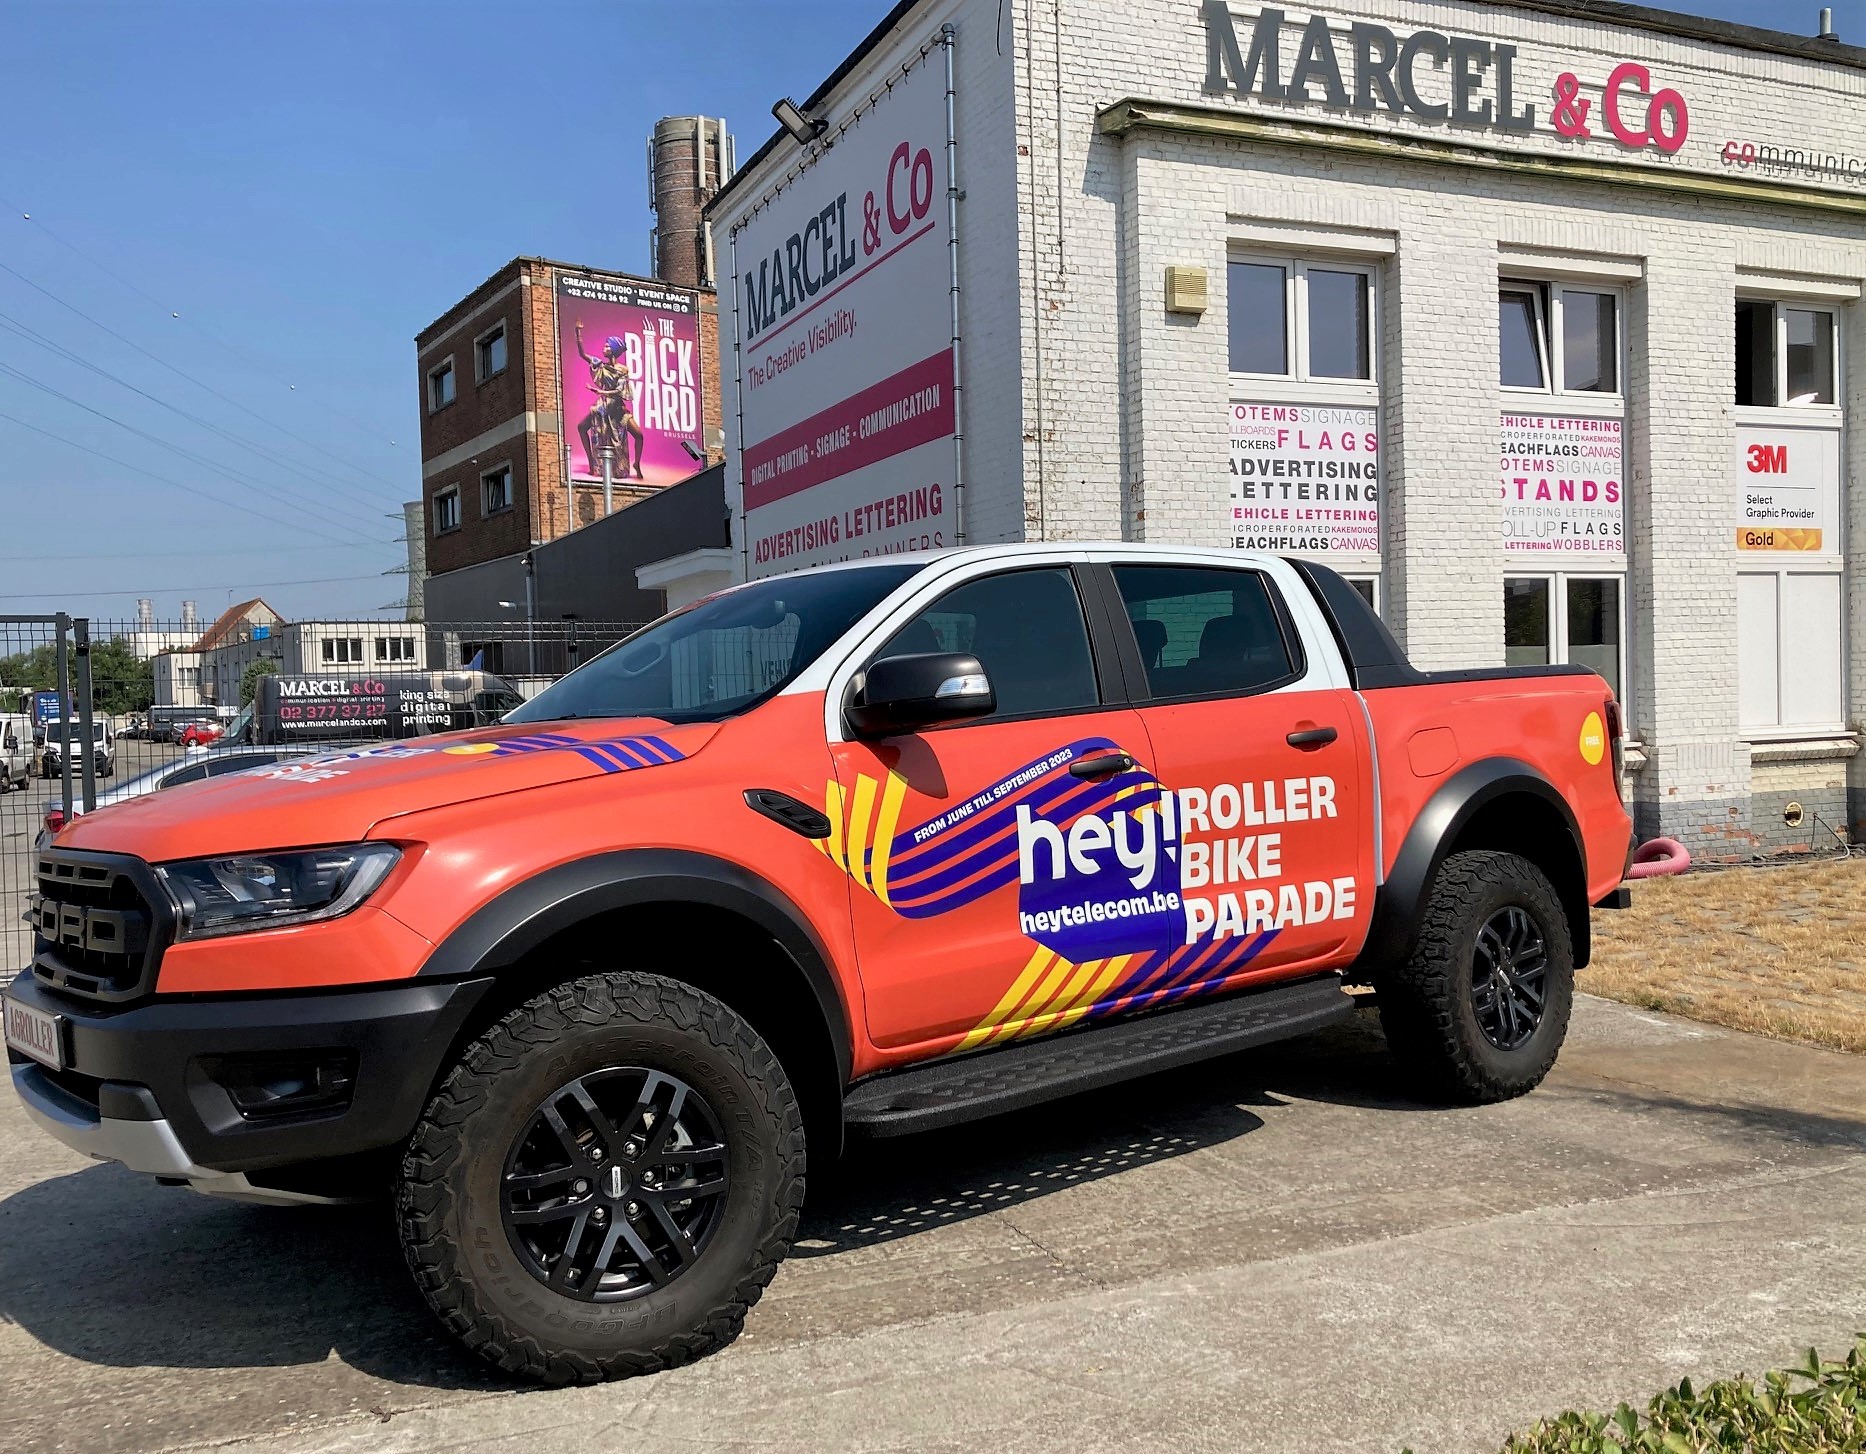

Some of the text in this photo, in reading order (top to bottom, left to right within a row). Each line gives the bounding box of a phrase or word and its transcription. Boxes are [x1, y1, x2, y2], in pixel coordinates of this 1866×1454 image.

[1205, 0, 1688, 152] MARCEL & Co
[1726, 141, 1866, 178] communic
[745, 142, 933, 340] MARCEL & Co
[562, 277, 690, 304] CREATIVE STUDIO EVENT SPACE
[582, 290, 596, 298] 474
[597, 292, 607, 300] 92
[637, 299, 652, 307] FIND
[658, 317, 675, 338] THE
[748, 308, 857, 391] The Creative Visibility.
[624, 331, 694, 388] BACK
[629, 378, 697, 433] YARD
[1230, 405, 1376, 425] OTEMS SIGNAGE
[1230, 426, 1275, 436] ILLBOARDS
[1551, 419, 1620, 432] LETTERING
[664, 431, 696, 440] BRUSSELS
[751, 464, 776, 486] DIGITAL
[777, 444, 809, 475] PRINTING
[816, 425, 850, 458] SIGNAGE
[859, 384, 940, 439] COMMUNICATION
[1277, 429, 1377, 452] FLAGS
[1500, 431, 1580, 442] CROPERFORATED
[1231, 439, 1276, 450] TICKERS
[1501, 442, 1620, 459] EACHFLAGS CANVAS
[1501, 458, 1620, 475] OTEMS SIGNAGE
[1746, 444, 1787, 473] 3M
[1746, 494, 1773, 505] Select
[1231, 508, 1377, 521] EHICLE LETTERING
[1502, 507, 1621, 518] VERTISING LETTERING
[1746, 507, 1815, 519] Graphic Provider
[755, 483, 943, 565] ADVERTISING LETTERING
[1233, 524, 1330, 534] ICROPERFORATED
[1501, 520, 1556, 537] OLL-UP
[1561, 522, 1621, 535] FLAGS
[1231, 536, 1377, 551] EACHFLAGS CANVAS
[1505, 539, 1622, 551] LETTERING WOBBLERS
[1745, 532, 1774, 546] Gold
[279, 680, 350, 696] MARCEL
[364, 679, 385, 694] Co
[399, 689, 424, 702] king
[402, 714, 451, 727] printing
[1585, 735, 1600, 747] FREE
[913, 748, 1073, 843] FROM JUNE TILL SEPTEMBER 2023
[1178, 775, 1338, 834] ROLLER
[1016, 790, 1177, 891] hey!
[1180, 833, 1282, 890] BIKE
[1019, 891, 1180, 934] heytelecom.be
[1183, 876, 1356, 946] PARADE
